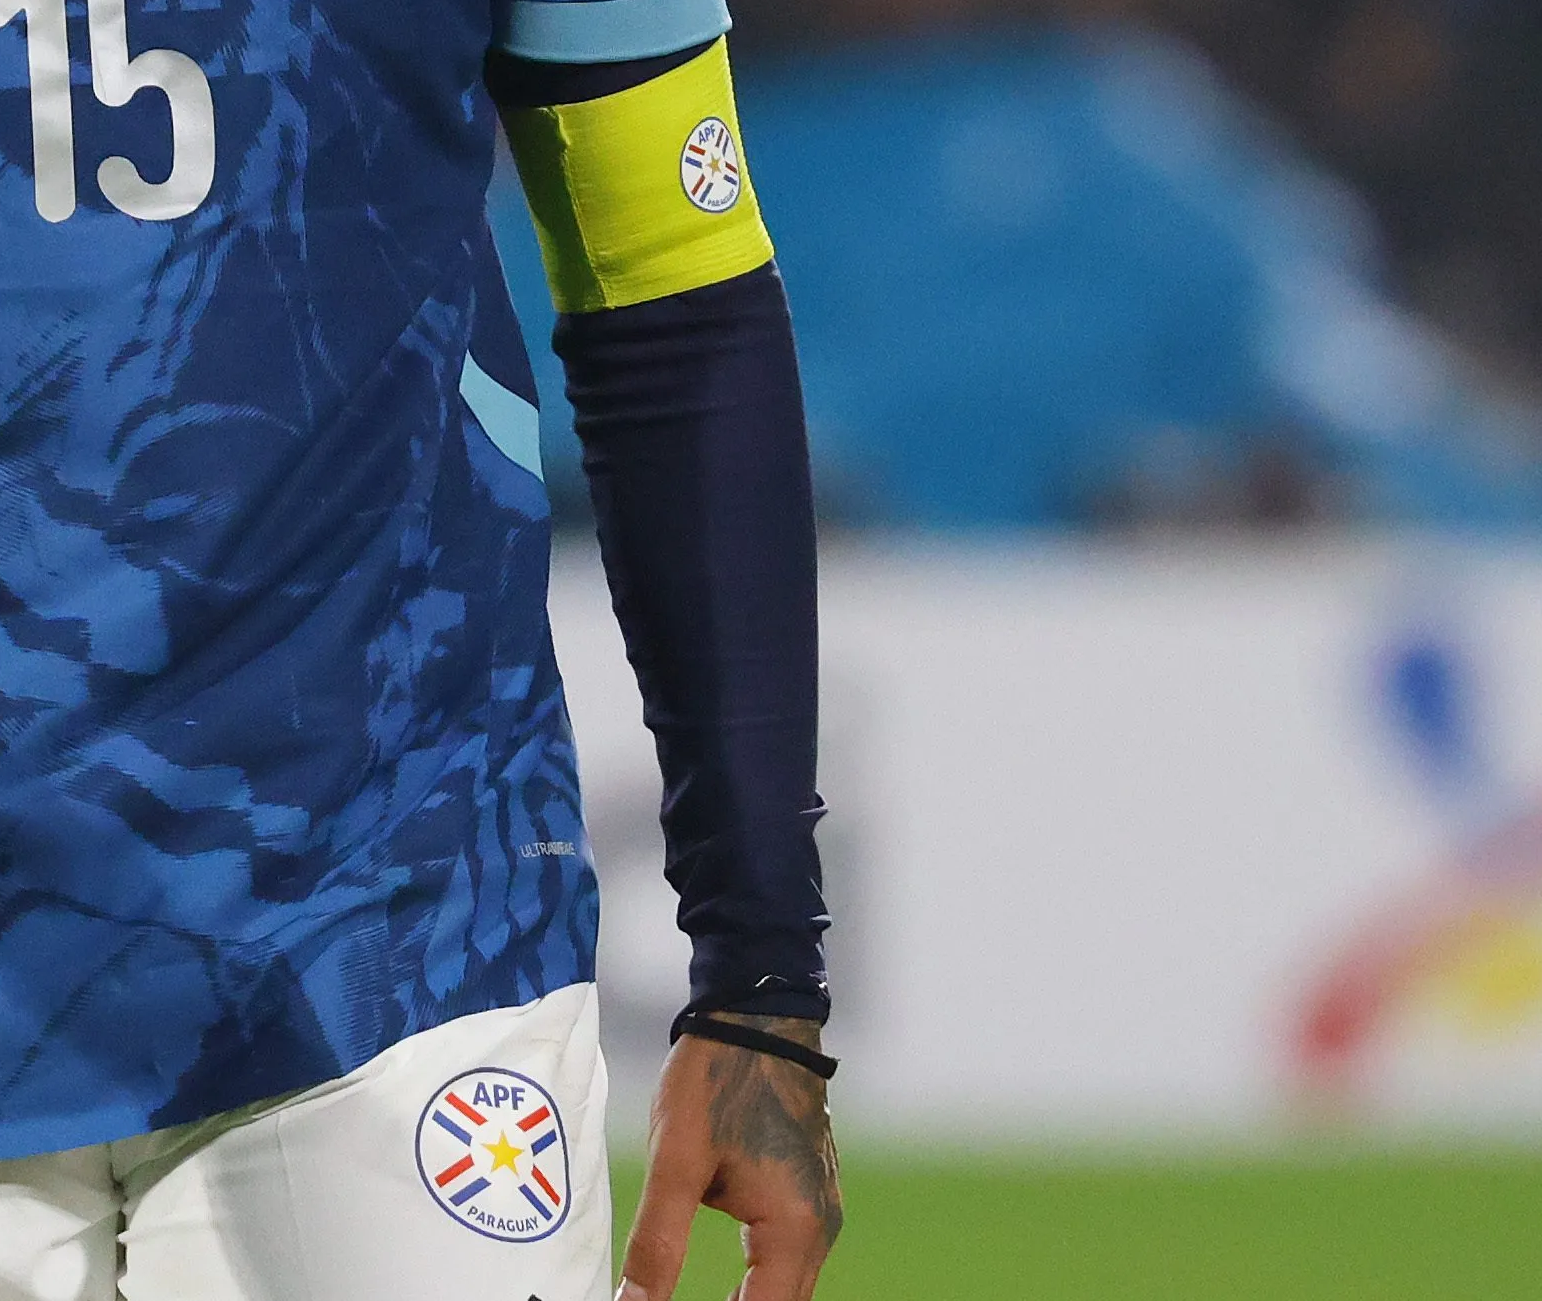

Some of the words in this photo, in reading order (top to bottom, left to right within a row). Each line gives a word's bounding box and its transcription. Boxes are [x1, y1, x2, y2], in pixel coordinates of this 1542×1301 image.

[698, 124, 716, 145] APF
[472, 1081, 526, 1111] APF
[467, 1206, 540, 1232] PARAGUAY
